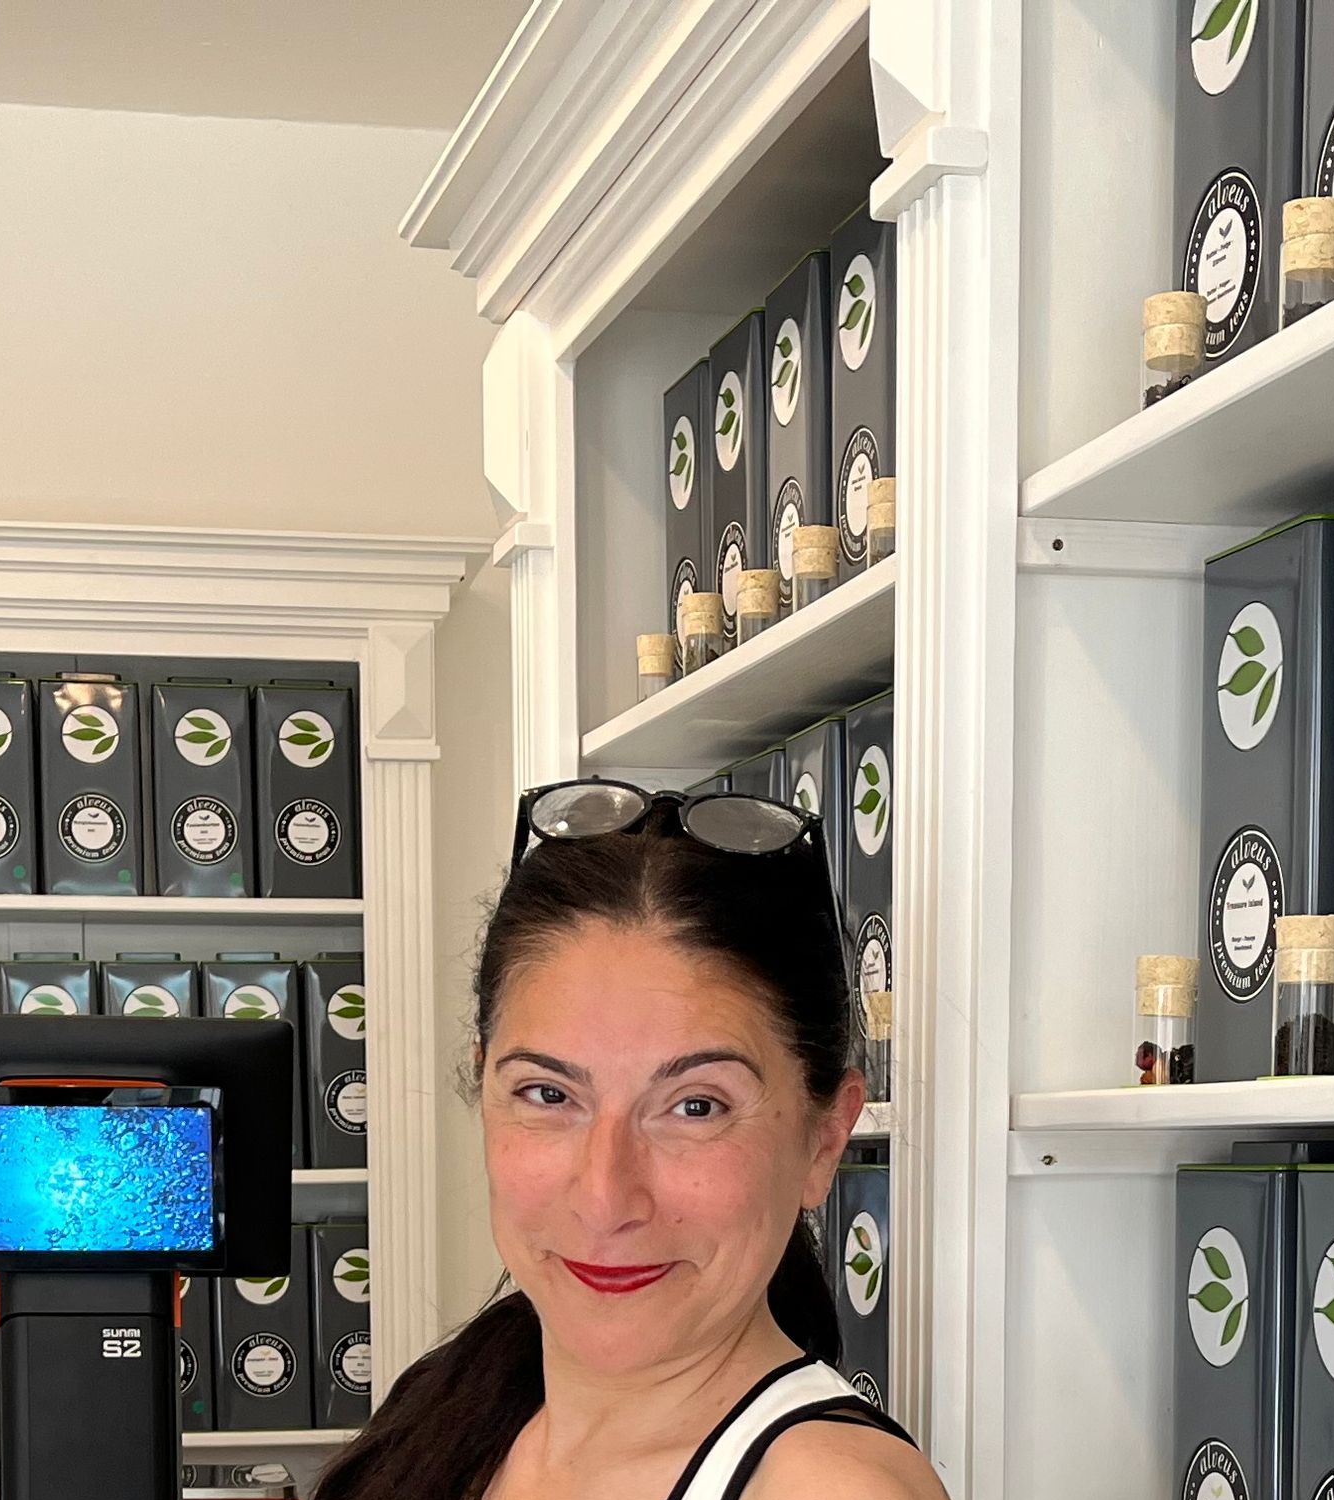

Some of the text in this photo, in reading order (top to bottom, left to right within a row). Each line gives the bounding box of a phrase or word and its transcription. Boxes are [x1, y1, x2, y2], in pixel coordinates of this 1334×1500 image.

[1208, 180, 1250, 219] alveus
[1229, 291, 1249, 333] teas
[1231, 834, 1272, 871] alveus
[1213, 941, 1274, 989] premium teas
[102, 1340, 142, 1357] S2
[1200, 1444, 1238, 1484] alveus
